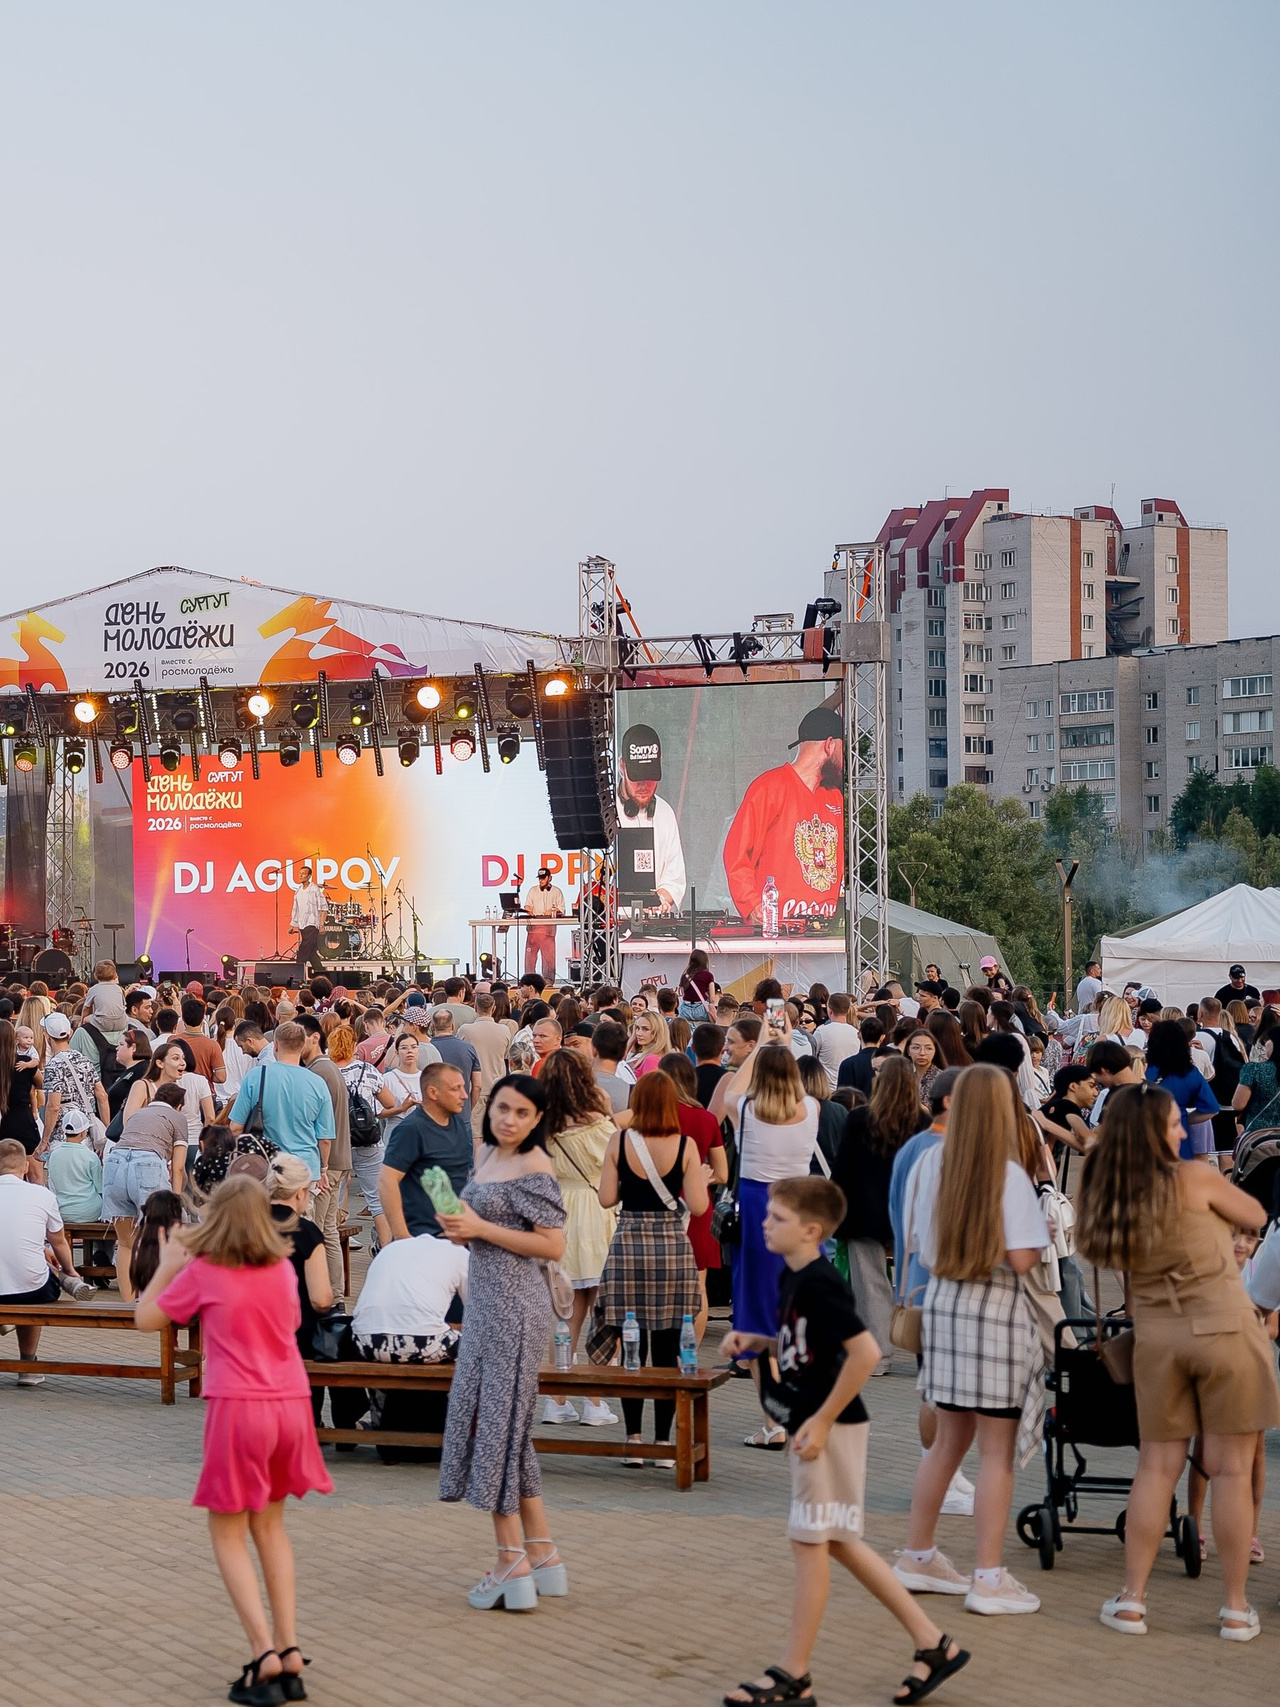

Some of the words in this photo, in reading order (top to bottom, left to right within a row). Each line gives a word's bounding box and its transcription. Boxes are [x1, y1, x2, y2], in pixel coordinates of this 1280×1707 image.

[180, 592, 230, 614] СУРГУТ
[104, 661, 150, 679] 2026
[161, 665, 234, 679] росмолодёжь
[207, 771, 244, 783] СУРГУТ
[147, 817, 182, 831] 2026
[174, 861, 214, 894] DJ
[225, 856, 401, 894] AGUPOV
[482, 854, 524, 887] DJ
